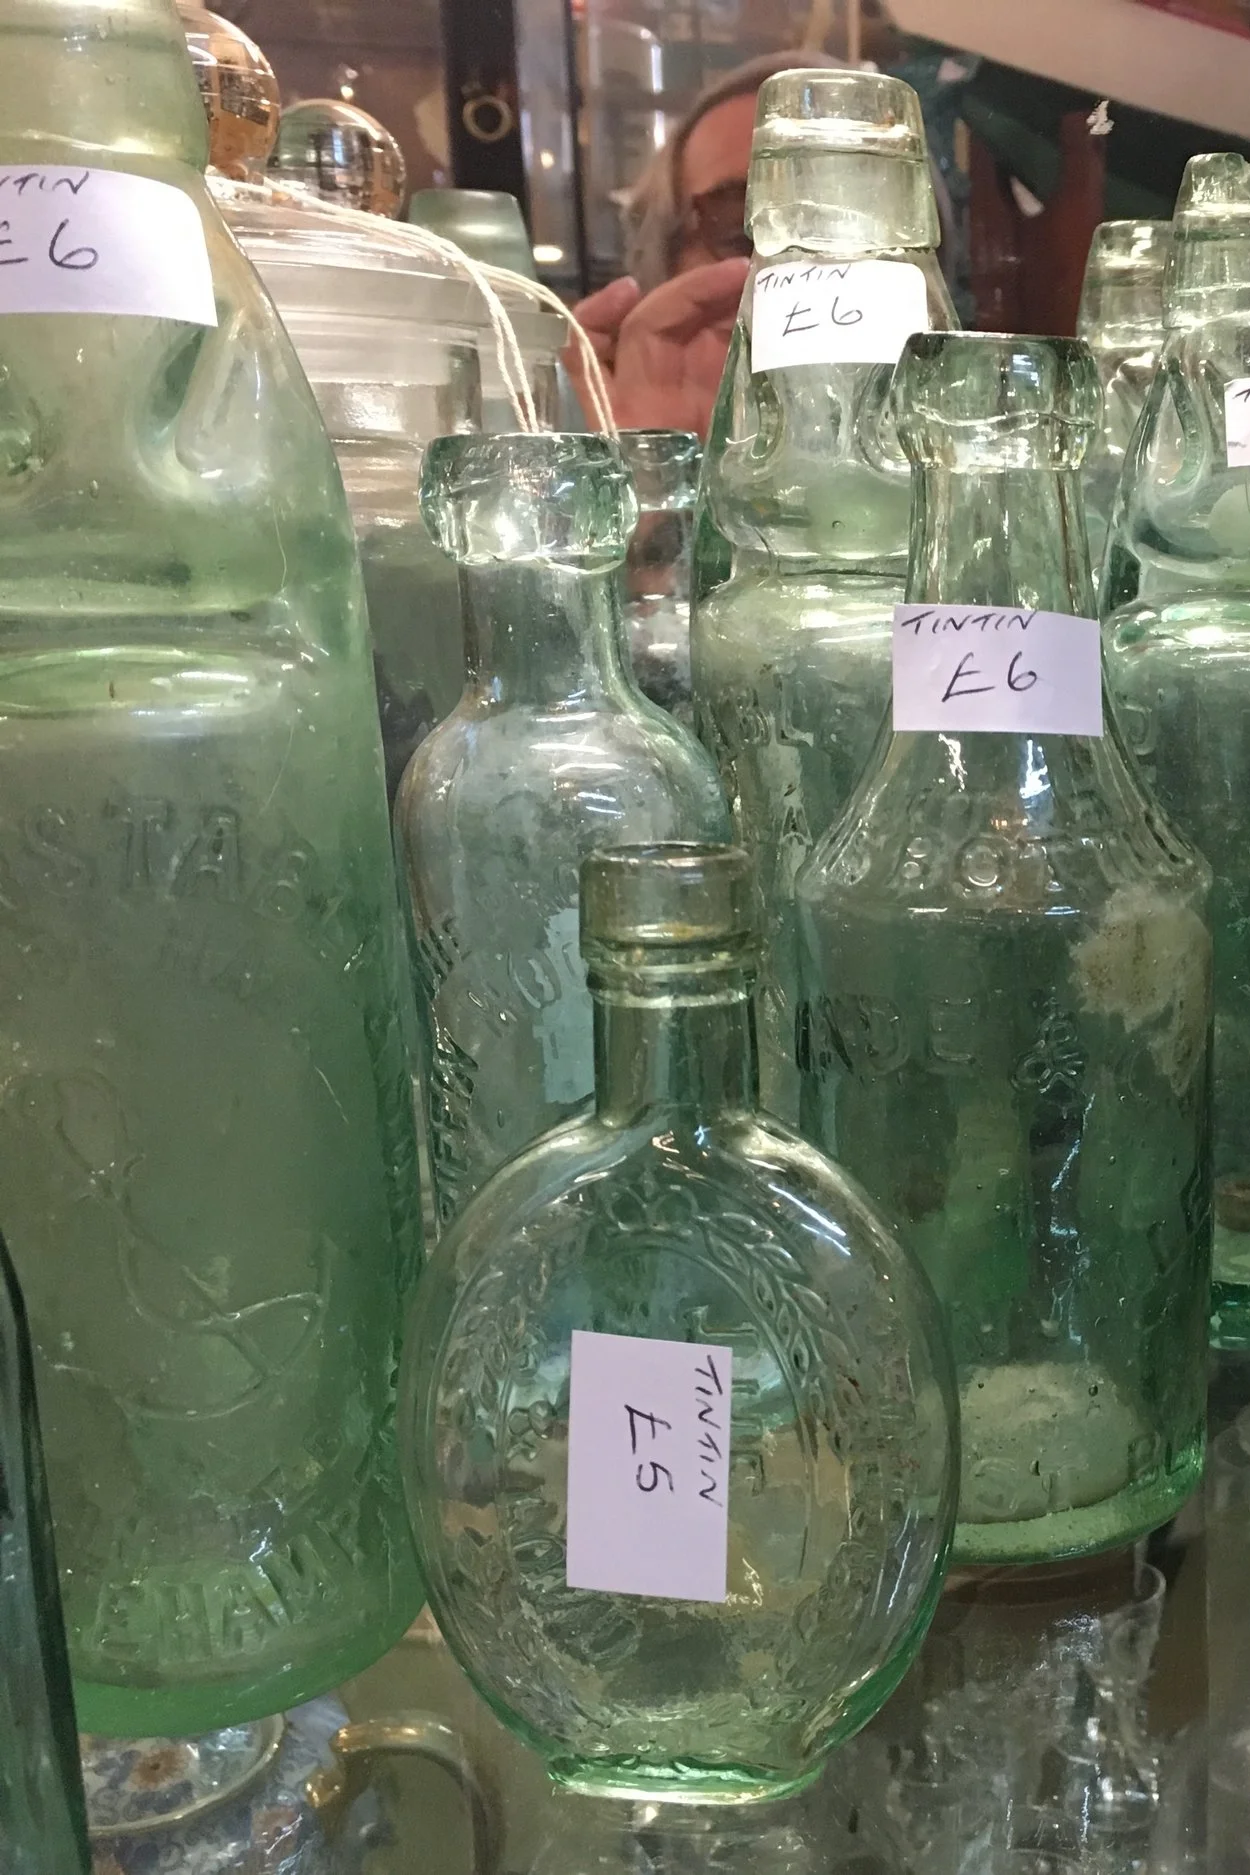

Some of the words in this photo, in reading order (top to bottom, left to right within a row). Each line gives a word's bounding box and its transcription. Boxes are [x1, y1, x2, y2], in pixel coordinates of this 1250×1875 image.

[757, 263, 851, 292] TINTIN
[782, 296, 863, 337] £6
[901, 609, 1037, 635] TINTIN
[941, 651, 1038, 702] £6
[624, 1404, 674, 1494] £5
[694, 1354, 724, 1508] TINTIN
